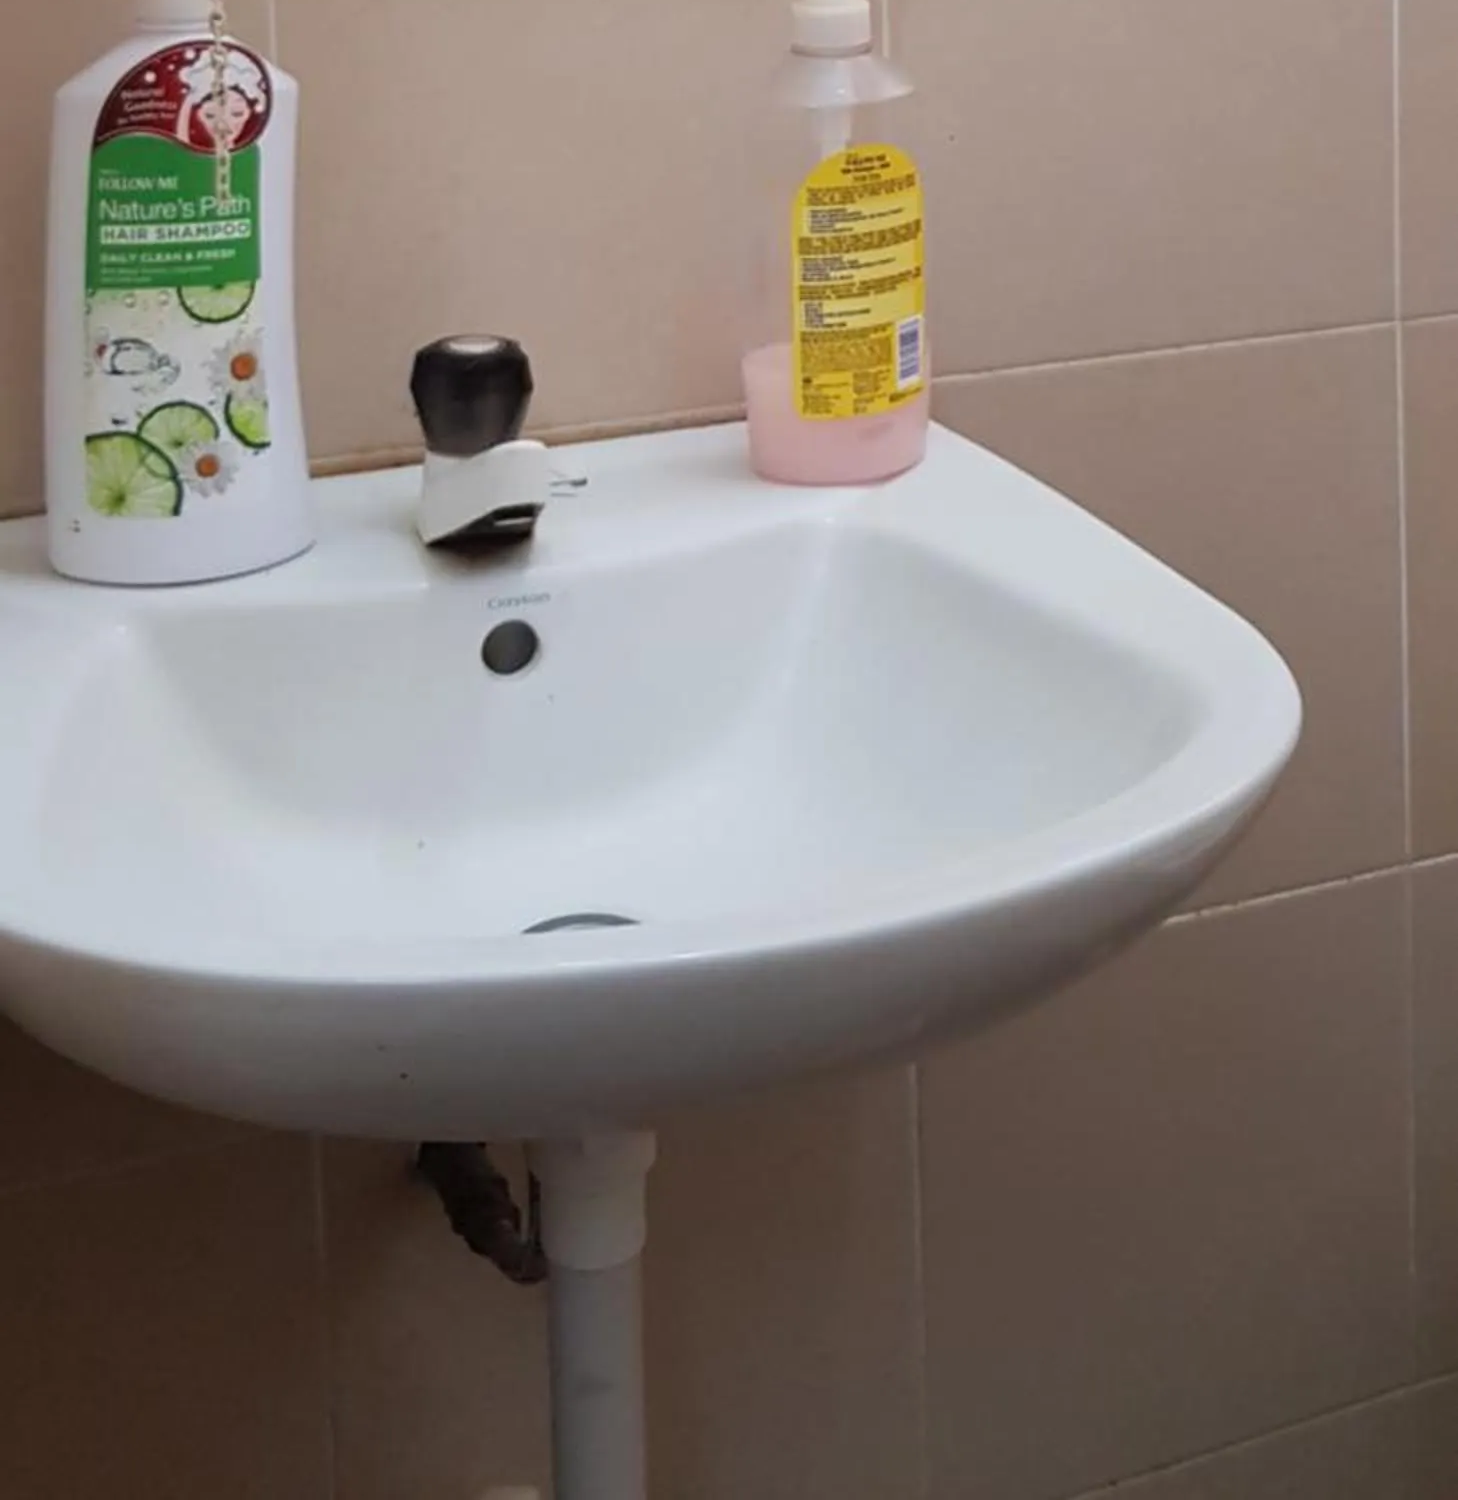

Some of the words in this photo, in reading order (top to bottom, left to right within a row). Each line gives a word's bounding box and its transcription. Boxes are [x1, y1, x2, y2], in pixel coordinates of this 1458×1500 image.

[98, 177, 153, 191] FOLLOW
[100, 198, 195, 221] Nature's
[201, 194, 251, 218] Path
[103, 227, 147, 240] HAIR
[154, 221, 249, 240] SHAMPOO
[101, 252, 137, 263] DAILY
[141, 251, 182, 262] CLEAN
[197, 248, 236, 260] FRESH
